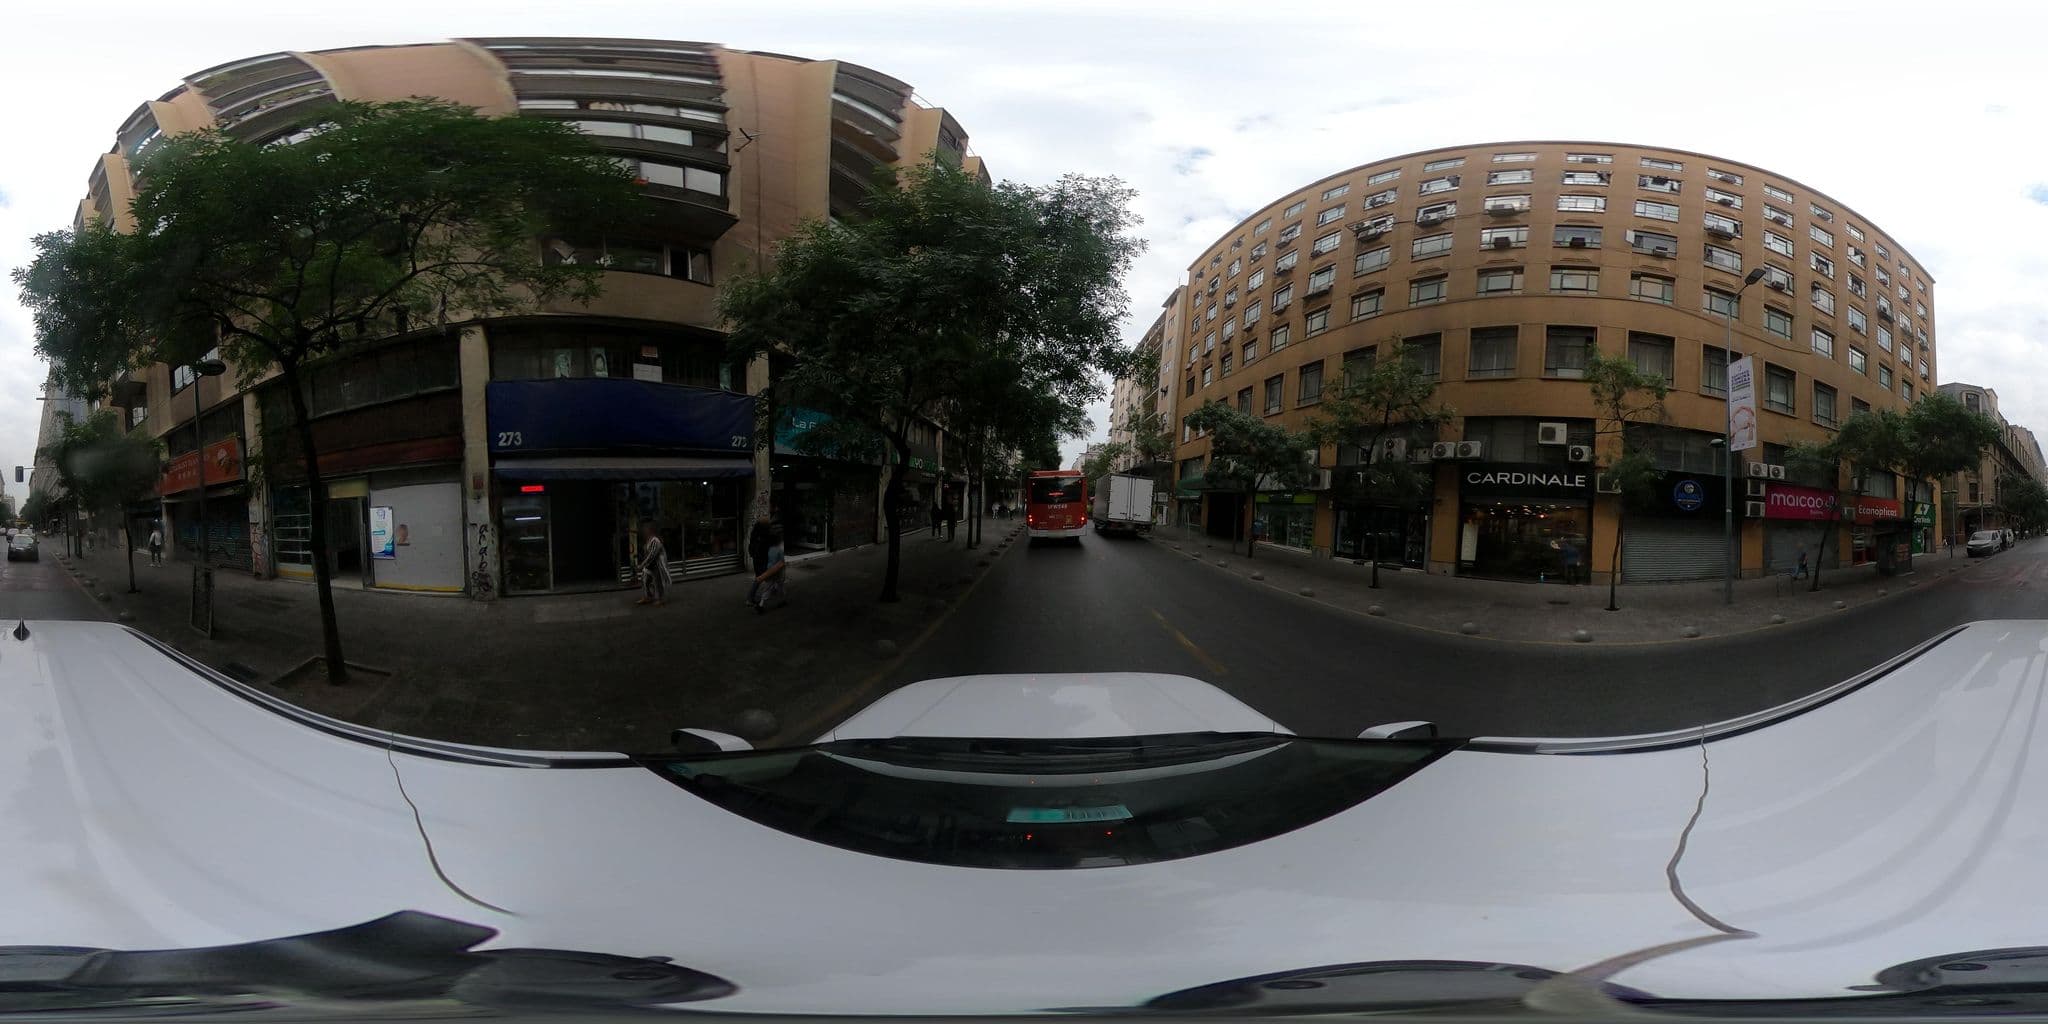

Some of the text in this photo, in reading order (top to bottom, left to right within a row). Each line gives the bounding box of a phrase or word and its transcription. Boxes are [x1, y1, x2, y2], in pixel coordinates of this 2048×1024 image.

[498, 432, 523, 447] 273
[1467, 472, 1587, 488] CARDINALE
[1770, 493, 1824, 509] maicao
